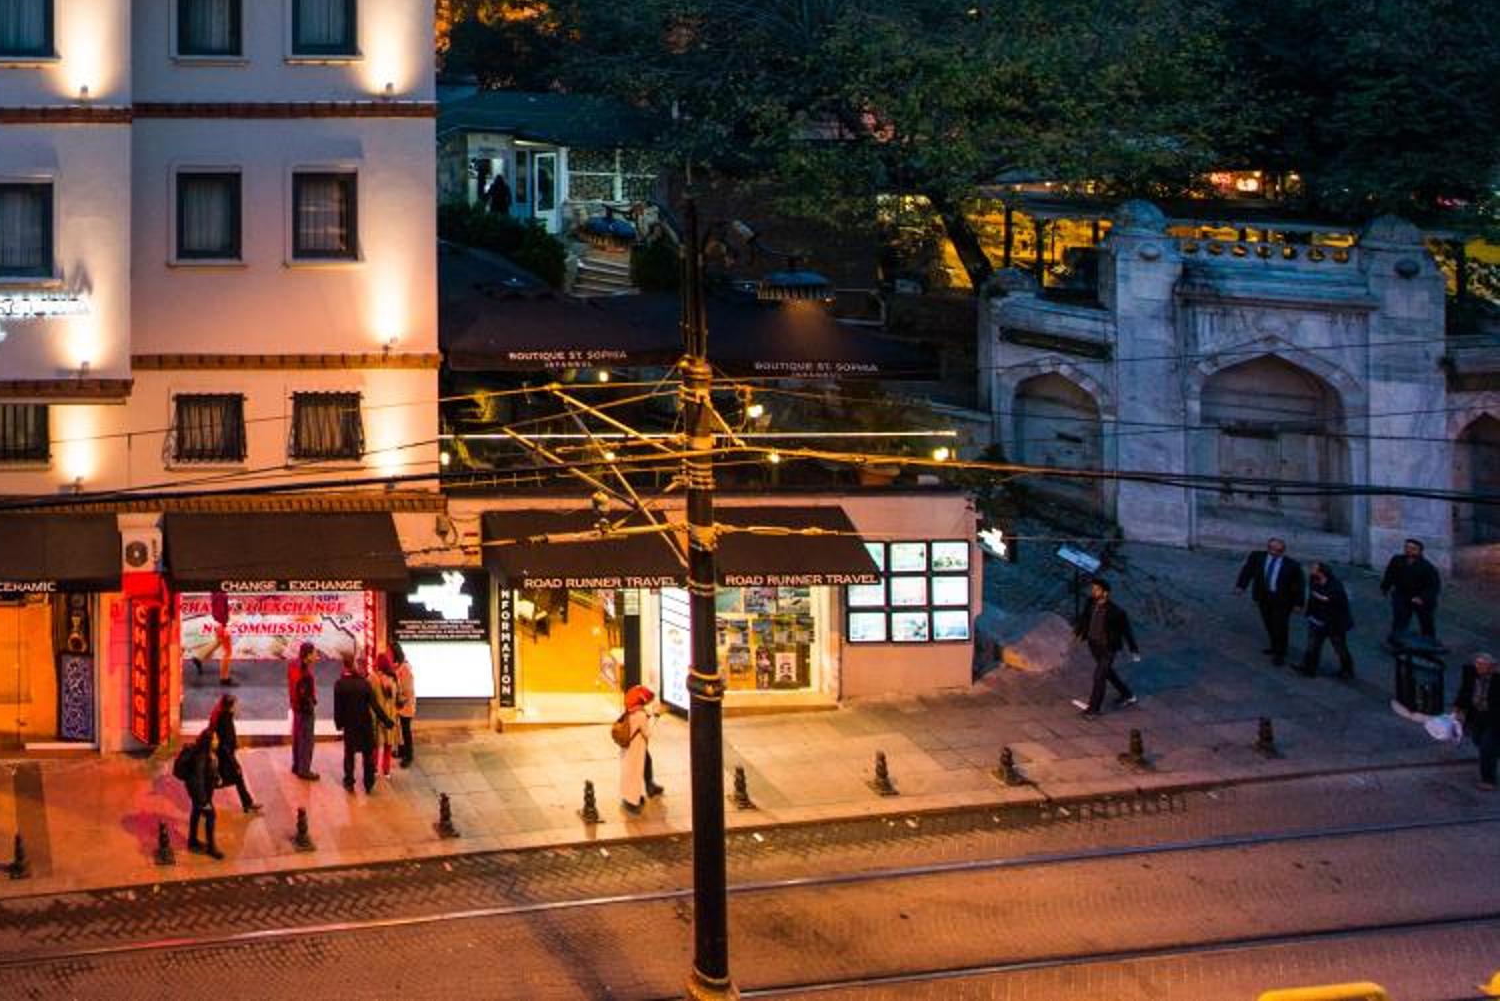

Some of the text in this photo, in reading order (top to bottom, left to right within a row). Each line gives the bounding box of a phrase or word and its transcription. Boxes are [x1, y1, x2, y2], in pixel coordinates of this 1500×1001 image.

[524, 576, 679, 588] ROAD RUNNER TRAVEL
[725, 574, 878, 585] ROAD RUNNER TRAVEL
[221, 580, 277, 591] CHANGE
[289, 580, 363, 590] EXCHANGE
[501, 590, 511, 695] NFORMATION
